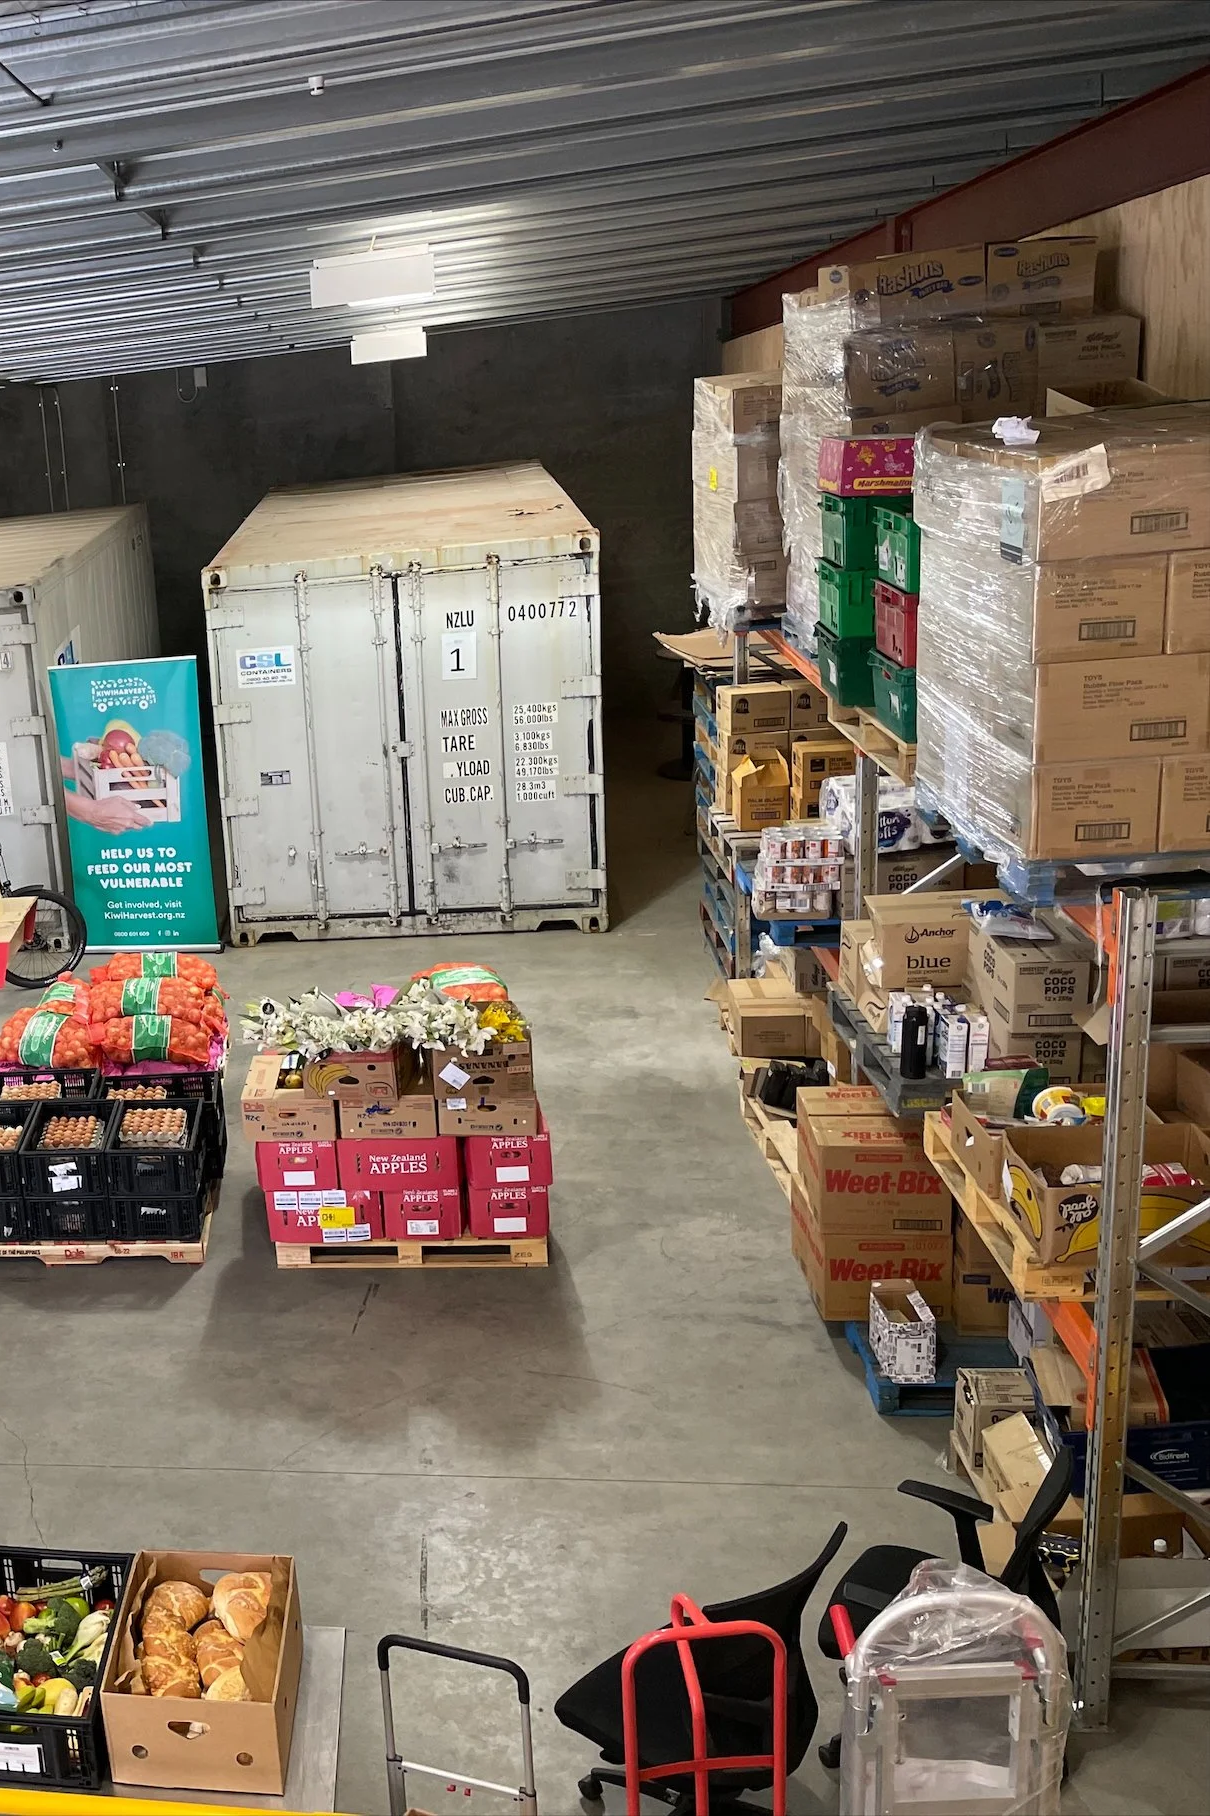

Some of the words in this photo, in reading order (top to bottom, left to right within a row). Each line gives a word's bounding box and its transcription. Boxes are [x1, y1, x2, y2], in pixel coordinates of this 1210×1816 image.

[1017, 253, 1070, 277] Rashuns
[857, 480, 913, 488] Marshmallo
[446, 610, 475, 629] NZLU
[508, 601, 577, 622] 0400772
[1, 653, 10, 669] 4
[239, 653, 292, 669] CSL
[450, 648, 465, 672] 1
[96, 687, 147, 697] KIWIHARVEST
[441, 709, 459, 728] MAX
[460, 707, 488, 726] GROSS
[442, 734, 476, 752] TARE
[101, 849, 133, 859] HELP
[136, 848, 154, 859] US
[157, 847, 177, 858] TO
[87, 864, 119, 875] FEED
[122, 863, 151, 873] OUR
[154, 862, 192, 873] MOST
[100, 877, 183, 889] VULNERABLE
[888, 873, 918, 882] COCO
[107, 901, 123, 909] Get
[125, 901, 163, 909] involved,
[164, 900, 182, 908] visit
[104, 912, 185, 920] KiwiHarvest.org.nz
[921, 927, 957, 937] Anchor
[906, 955, 951, 969] blue
[1044, 977, 1077, 986] COCO
[1044, 986, 1075, 995] POPS
[1035, 1040, 1067, 1049] COCO
[1035, 1050, 1066, 1058] POPS
[243, 1102, 265, 1112] Dole
[279, 1146, 313, 1154] APPLES
[491, 1140, 528, 1149] APPLES
[369, 1155, 390, 1163] New
[391, 1153, 427, 1162] Zealand
[369, 1162, 428, 1175] APPLES
[825, 1169, 943, 1195] Weet-Bix
[403, 1194, 439, 1202] APPLES
[491, 1191, 527, 1200] APPLES
[1060, 1195, 1097, 1219] good
[1069, 1209, 1092, 1223] all
[64, 1248, 85, 1259] Dole
[829, 1258, 944, 1282] Weet-Bix
